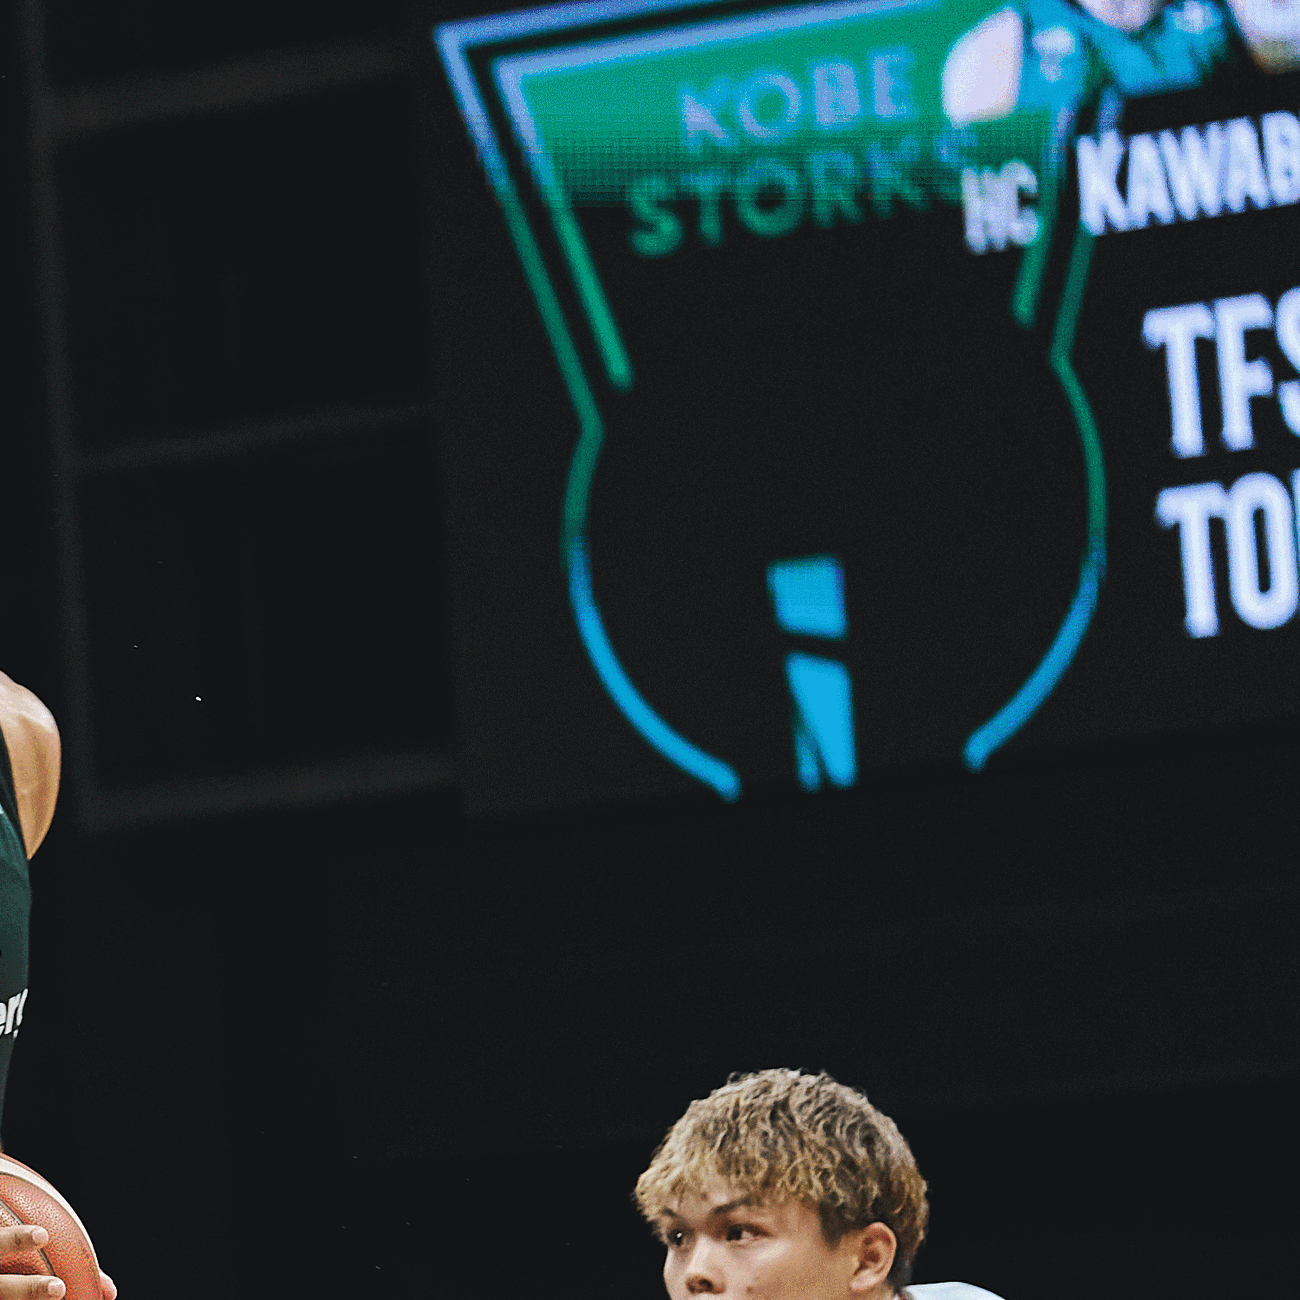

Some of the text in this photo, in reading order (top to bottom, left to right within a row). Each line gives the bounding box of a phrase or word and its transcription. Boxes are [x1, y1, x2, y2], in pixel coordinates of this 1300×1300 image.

[678, 46, 916, 150] KOBE
[960, 161, 1041, 255] HC
[1155, 468, 1300, 638] TO
